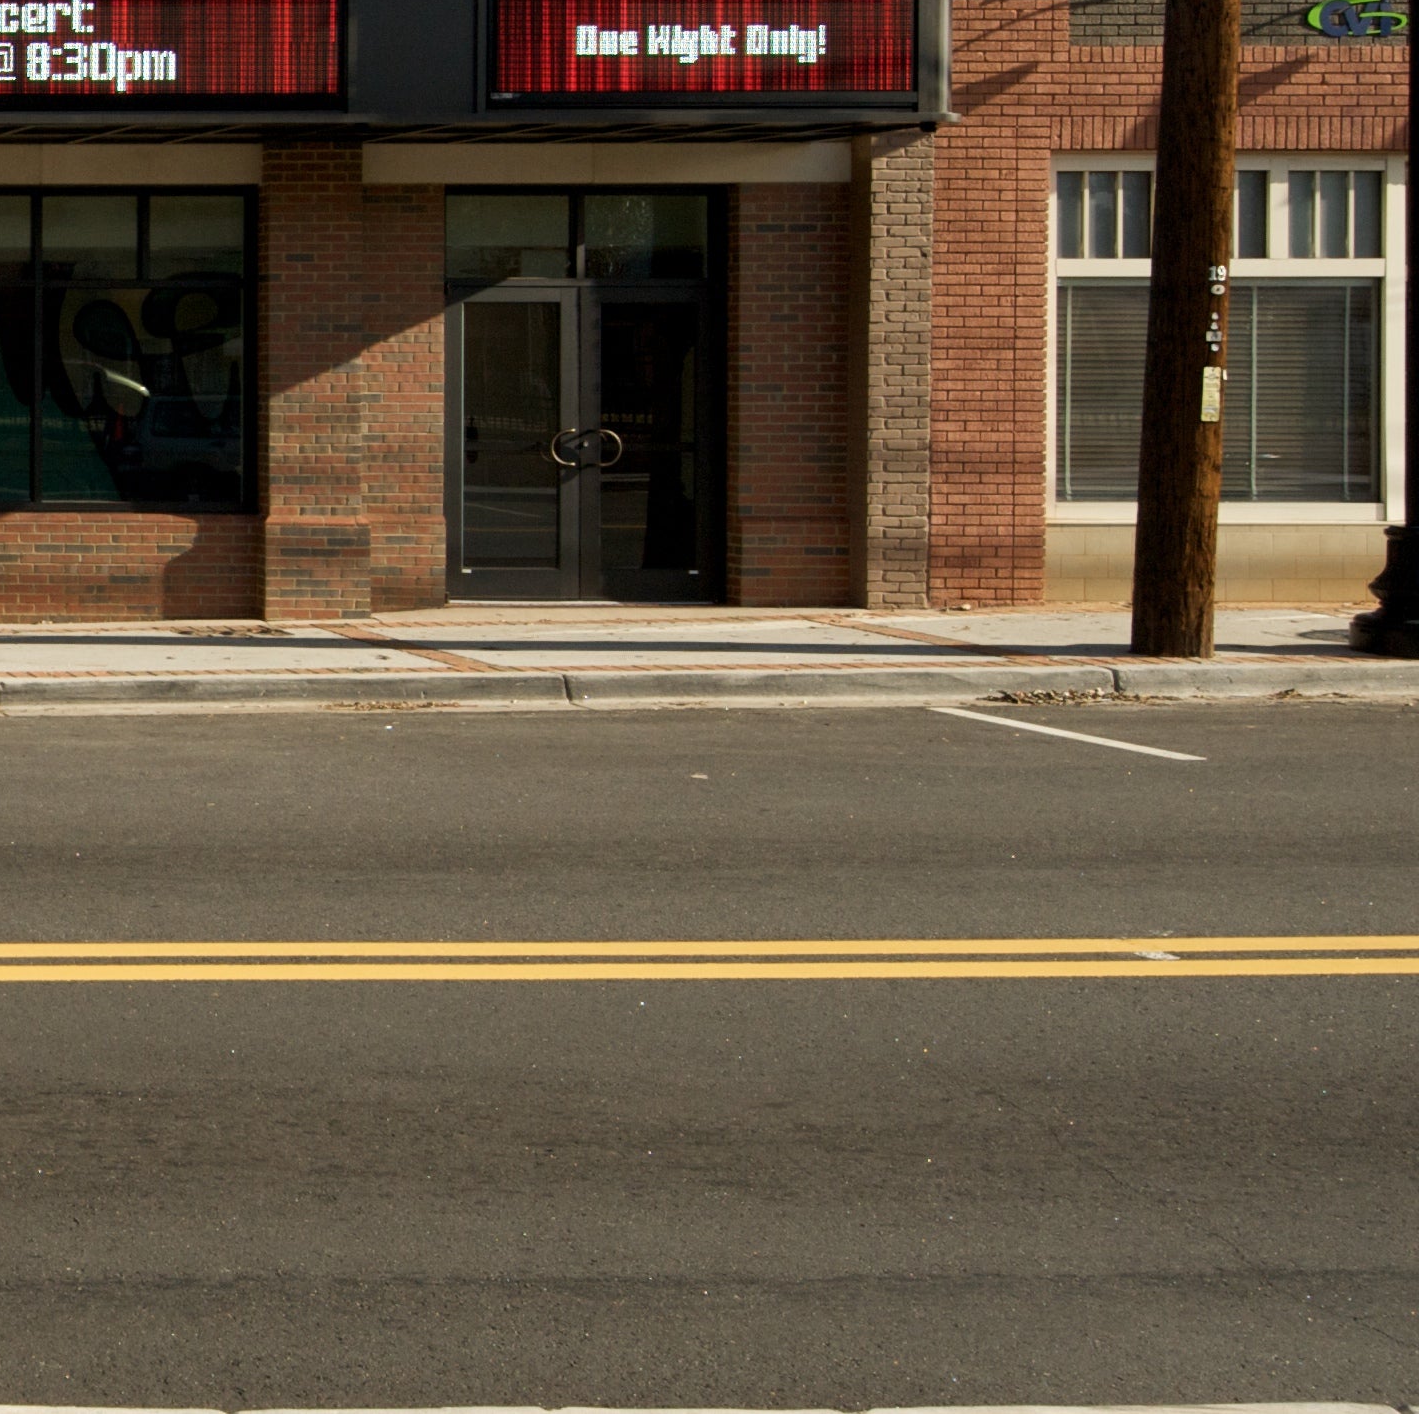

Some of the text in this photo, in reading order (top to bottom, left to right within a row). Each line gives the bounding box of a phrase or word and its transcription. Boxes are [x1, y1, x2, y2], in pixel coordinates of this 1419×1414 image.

[575, 24, 827, 64] One Night Only!
[27, 42, 178, 93] 8:30pm
[1208, 265, 1227, 281] 19
